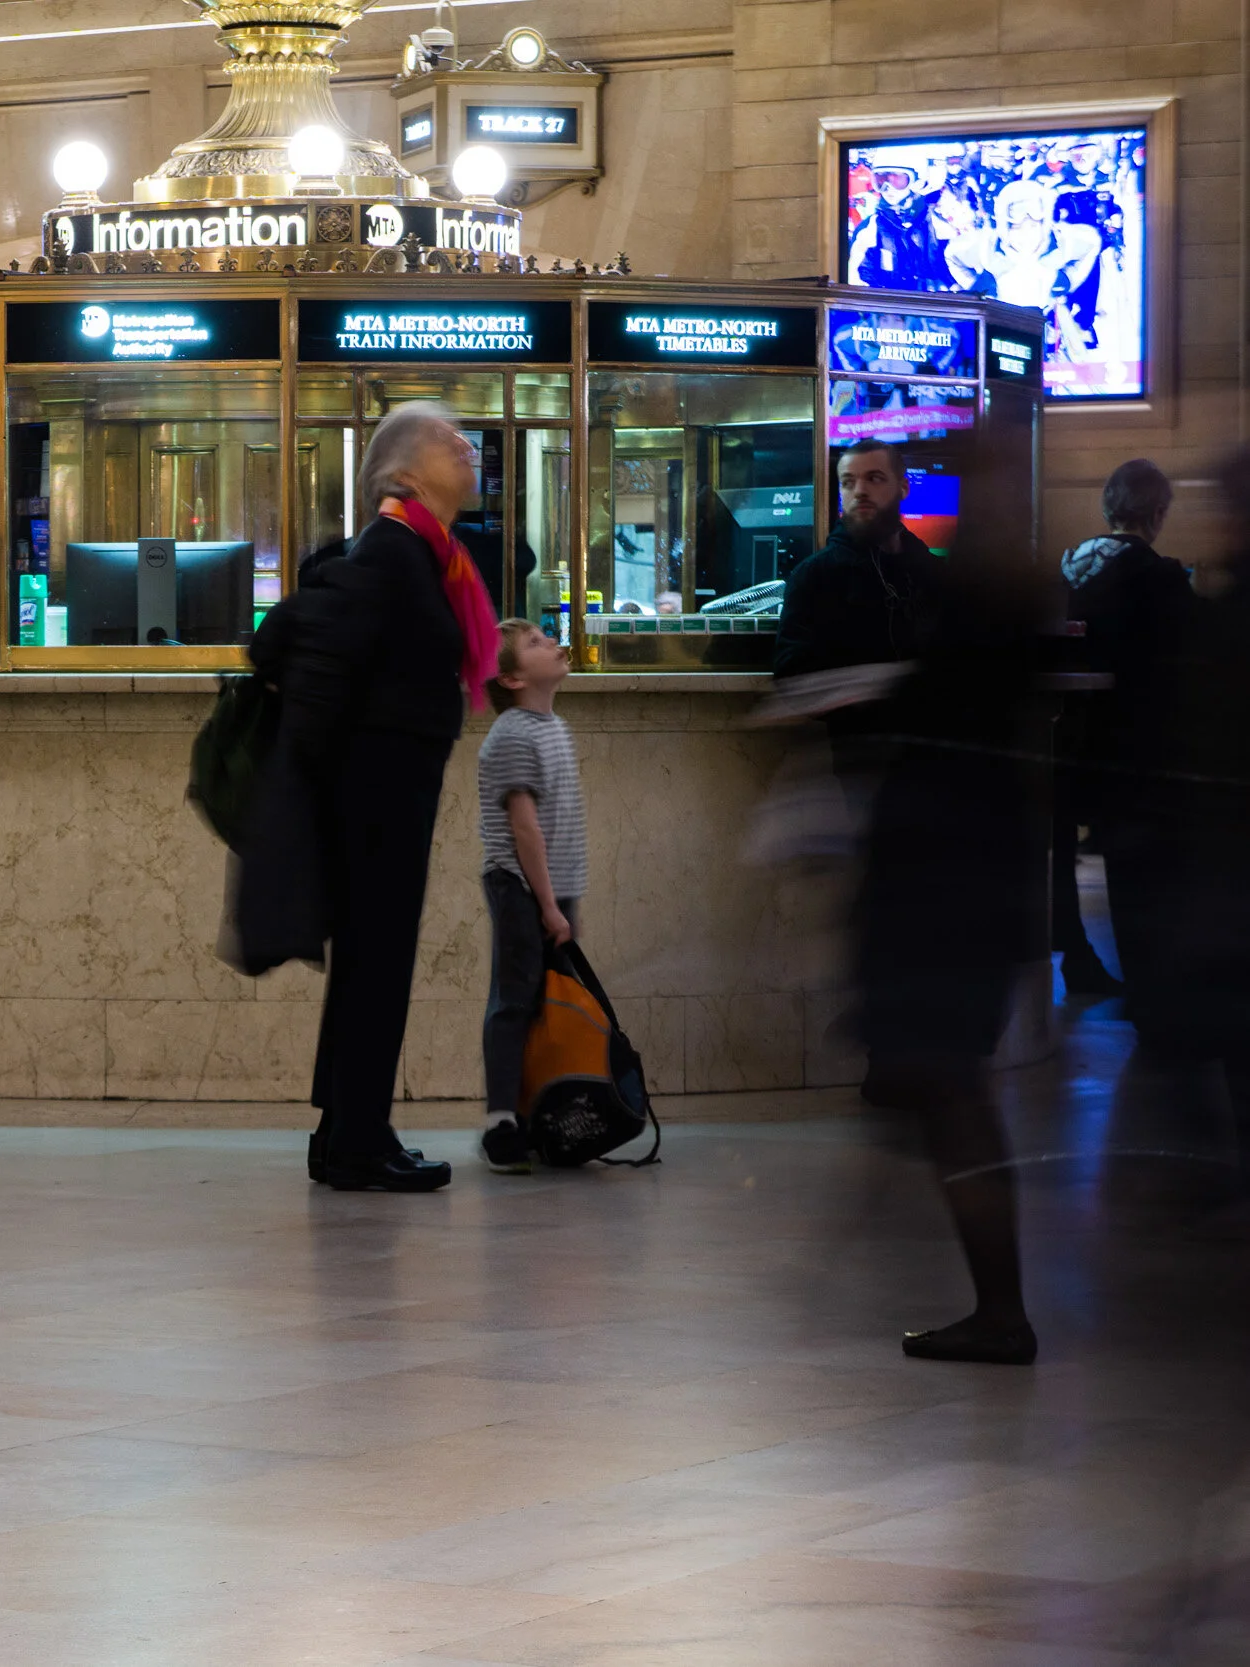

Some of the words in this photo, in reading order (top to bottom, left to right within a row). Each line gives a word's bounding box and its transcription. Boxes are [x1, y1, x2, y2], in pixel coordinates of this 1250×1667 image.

[478, 115, 543, 132] TRACK
[545, 117, 565, 133] 27
[93, 206, 306, 254] Information
[367, 213, 396, 238] MTA
[344, 315, 385, 331] MTA
[388, 315, 525, 332] METRO-NORTH
[626, 317, 660, 333] MTA
[663, 318, 777, 336] METRO-NORTH
[336, 333, 396, 349] TRAIN
[400, 334, 533, 350] INFORMATION
[656, 336, 748, 353] TIMETABLES
[852, 326, 875, 341] MTA
[877, 328, 952, 347] METRO-NORTH
[878, 345, 928, 362] ARRIVALS
[773, 492, 801, 505] DELL
